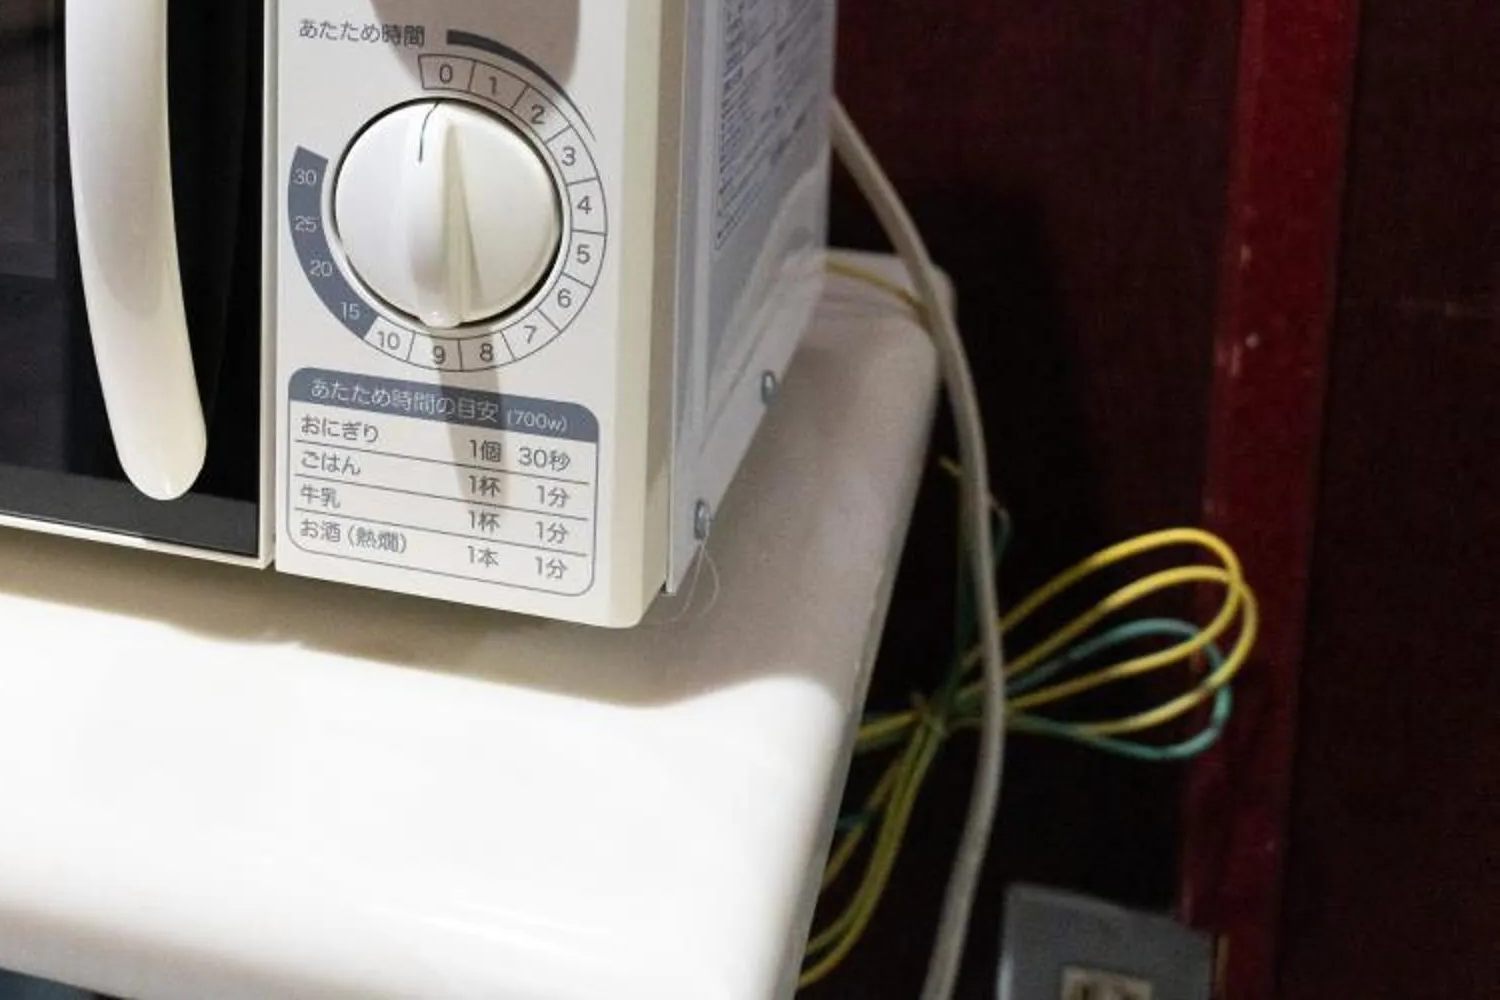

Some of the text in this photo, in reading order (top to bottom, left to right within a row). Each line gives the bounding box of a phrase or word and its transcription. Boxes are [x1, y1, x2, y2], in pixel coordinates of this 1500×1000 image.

[299, 19, 425, 47] あたため時間
[439, 64, 452, 84] 0
[489, 76, 499, 94] 1
[531, 104, 545, 125] 2
[562, 147, 576, 166] 3
[292, 169, 317, 184] 30
[577, 196, 592, 214] 4
[295, 217, 318, 232] 25
[577, 245, 590, 264] 5
[310, 260, 332, 276] 20
[557, 289, 571, 308] 6
[341, 302, 360, 320] 15
[378, 331, 401, 350] 10
[525, 326, 538, 344] 7
[433, 346, 445, 364] 9
[480, 343, 493, 361] 8
[311, 379, 499, 422] あたため時間の目安
[301, 415, 571, 471] おにぎり 1個 30秒
[301, 451, 569, 508] ごはん 1杯 1分
[300, 485, 568, 544] 牛乳 1杯 1分
[467, 545, 499, 568] 1本
[536, 557, 567, 580] 1分
